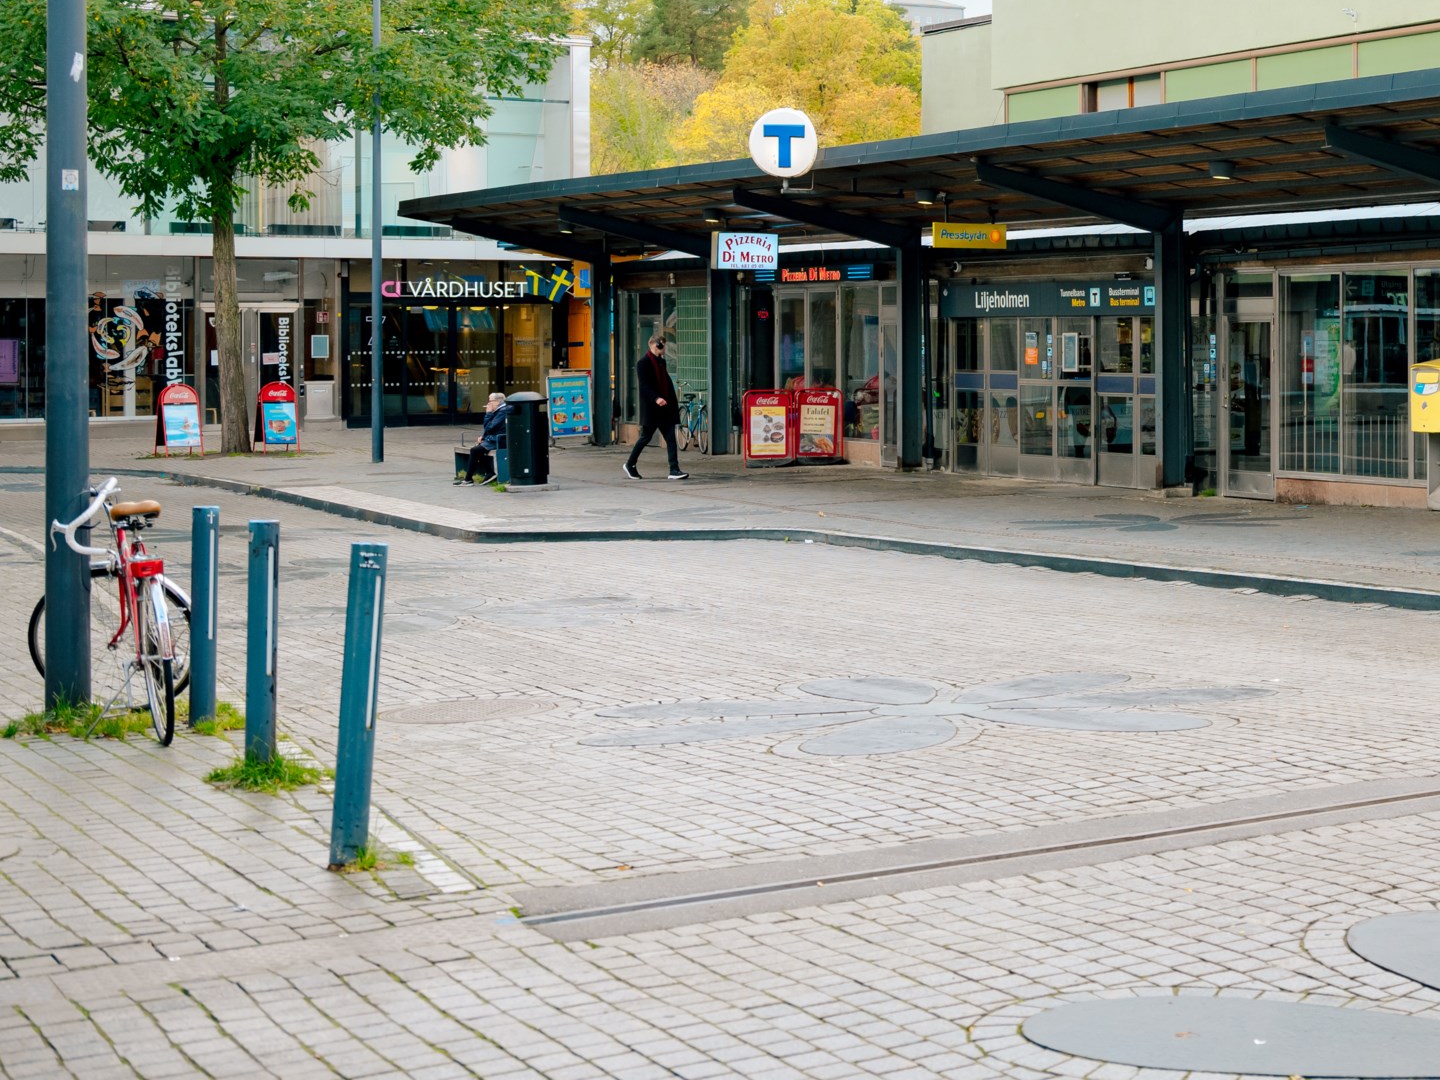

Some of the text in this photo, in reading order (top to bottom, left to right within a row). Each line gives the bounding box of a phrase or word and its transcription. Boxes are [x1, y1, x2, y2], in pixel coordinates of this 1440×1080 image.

[763, 124, 805, 168] T
[940, 229, 987, 242] Pressbyrån
[408, 278, 528, 298] VÅRDHUSET
[1060, 289, 1086, 297] Tunnelbana
[1108, 288, 1139, 296] Bussterminal
[975, 291, 1029, 312] Liljeholmen
[1071, 298, 1139, 307] Metro Bus terminal
[756, 397, 779, 405] Coca-Cola
[806, 395, 829, 404] Coca-Cola
